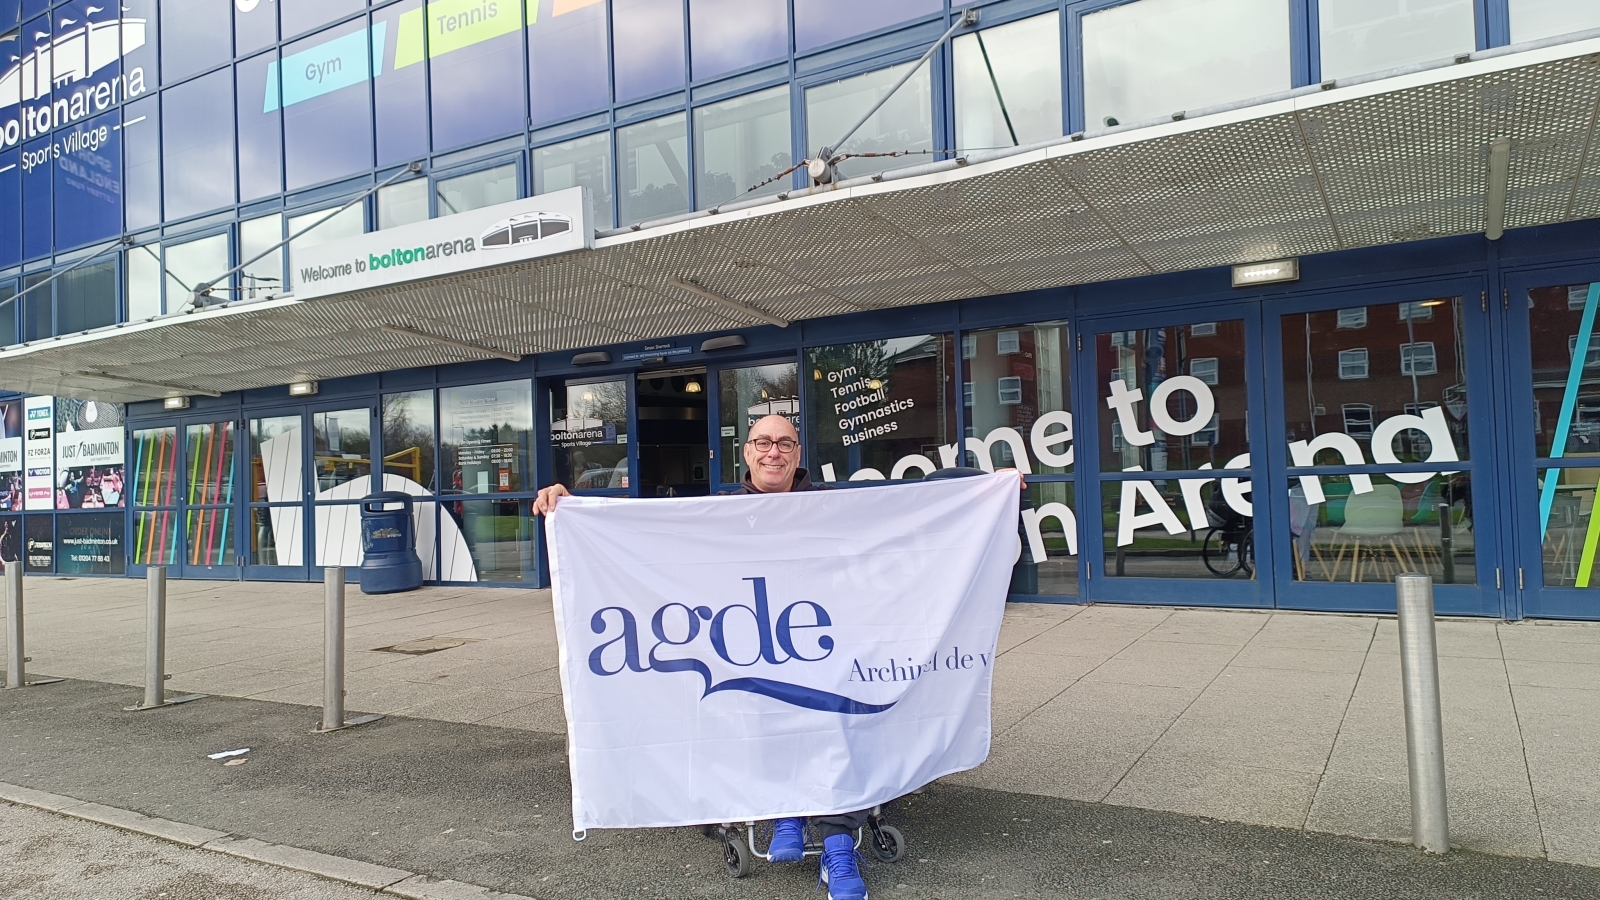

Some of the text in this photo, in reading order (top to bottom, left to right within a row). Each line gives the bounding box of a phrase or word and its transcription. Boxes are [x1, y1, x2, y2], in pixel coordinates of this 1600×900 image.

[436, 1, 498, 35] Tennis
[305, 55, 342, 83] Gym
[62, 124, 108, 155] Village
[300, 236, 475, 283] Welcome to boltonarena
[827, 366, 857, 383] Gym
[830, 377, 871, 399] Tennis
[834, 388, 885, 415] Football
[838, 398, 915, 431] Gymnastics
[1107, 375, 1215, 447] to
[842, 421, 898, 446] Business
[28, 447, 51, 457] FZ FORZA
[62, 441, 120, 459] JUST BADMINTON
[1117, 406, 1459, 547] Arena
[587, 577, 834, 698] agde
[946, 646, 973, 671] de
